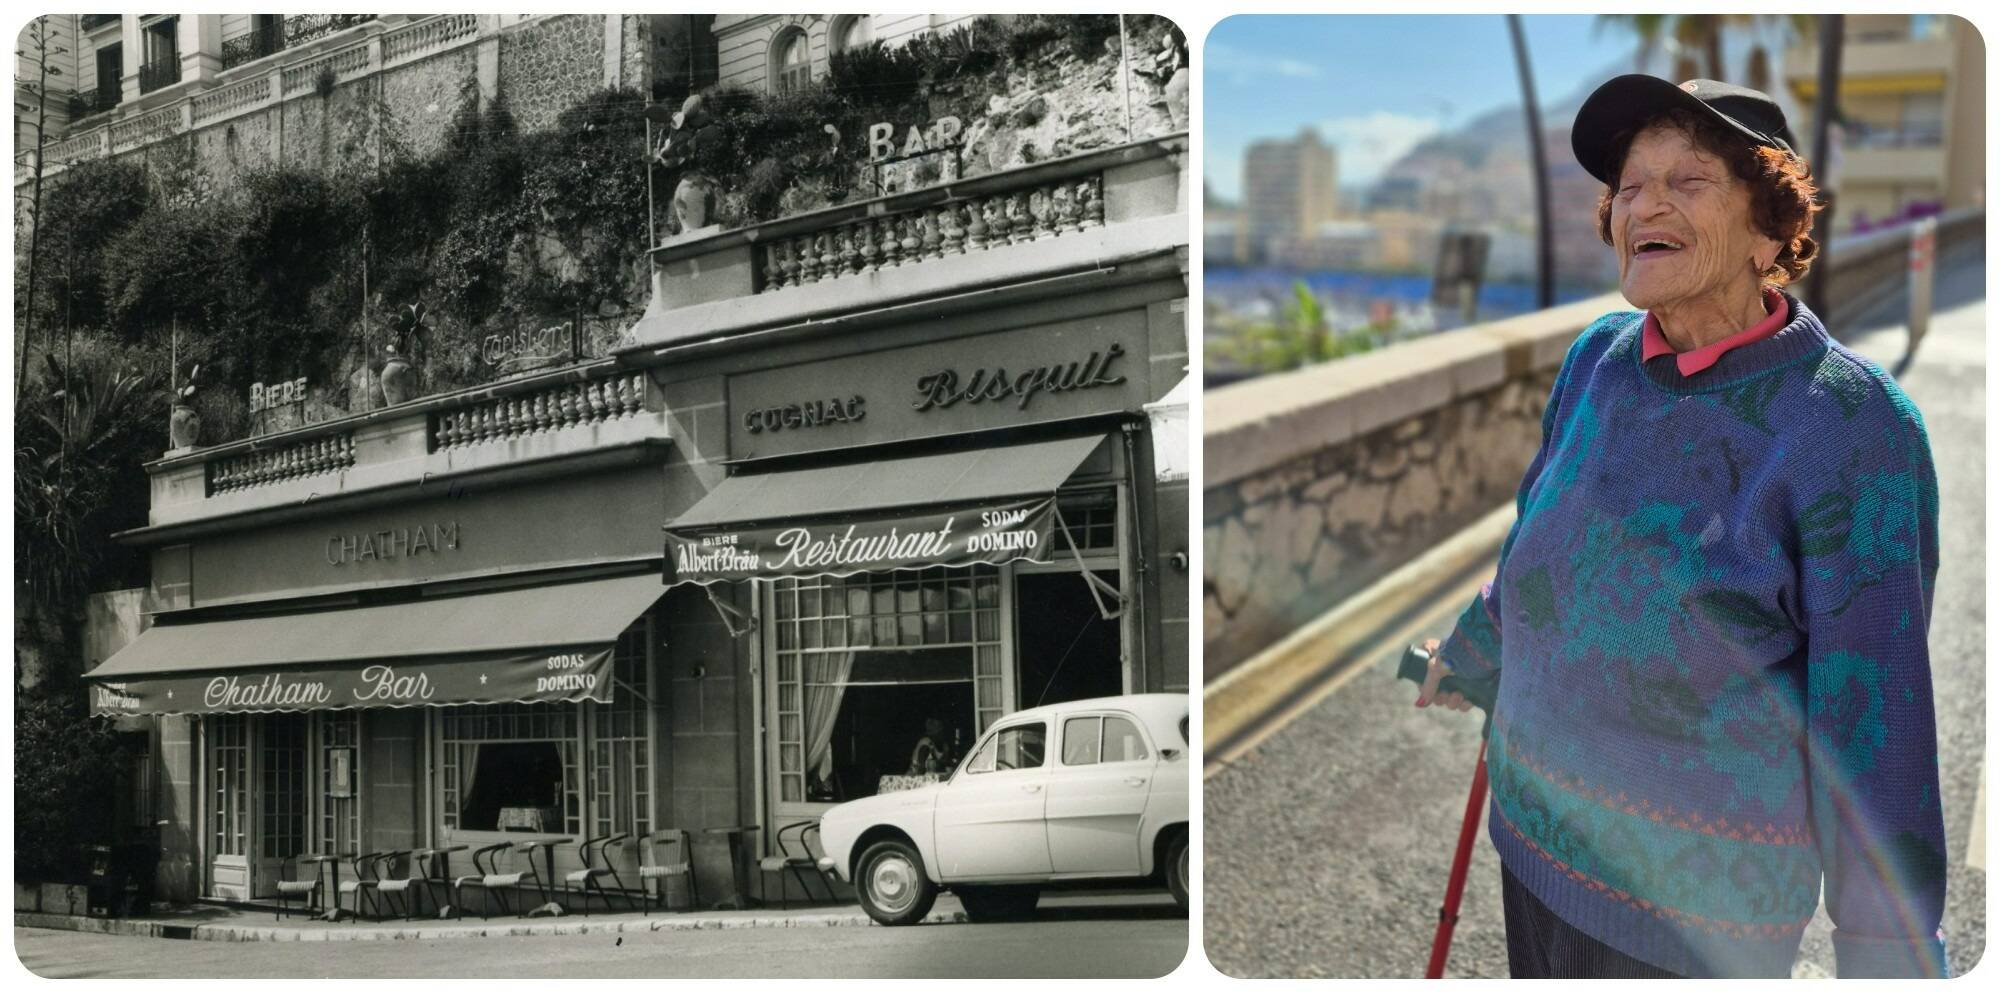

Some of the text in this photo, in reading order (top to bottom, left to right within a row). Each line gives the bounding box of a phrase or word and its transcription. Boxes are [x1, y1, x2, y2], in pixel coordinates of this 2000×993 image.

[869, 116, 961, 163] BAR
[249, 376, 307, 412] BIERE
[742, 342, 1127, 434] COGNAC Bisquit
[982, 509, 1029, 528] SODAS
[327, 521, 459, 566] CHATHAM
[703, 535, 738, 546] BIERE
[766, 516, 955, 570] Restaurant
[966, 530, 1038, 553] DOMINO
[547, 654, 585, 670] SODAS
[204, 665, 434, 708] Chatham Bar
[536, 673, 596, 693] DOMINO
